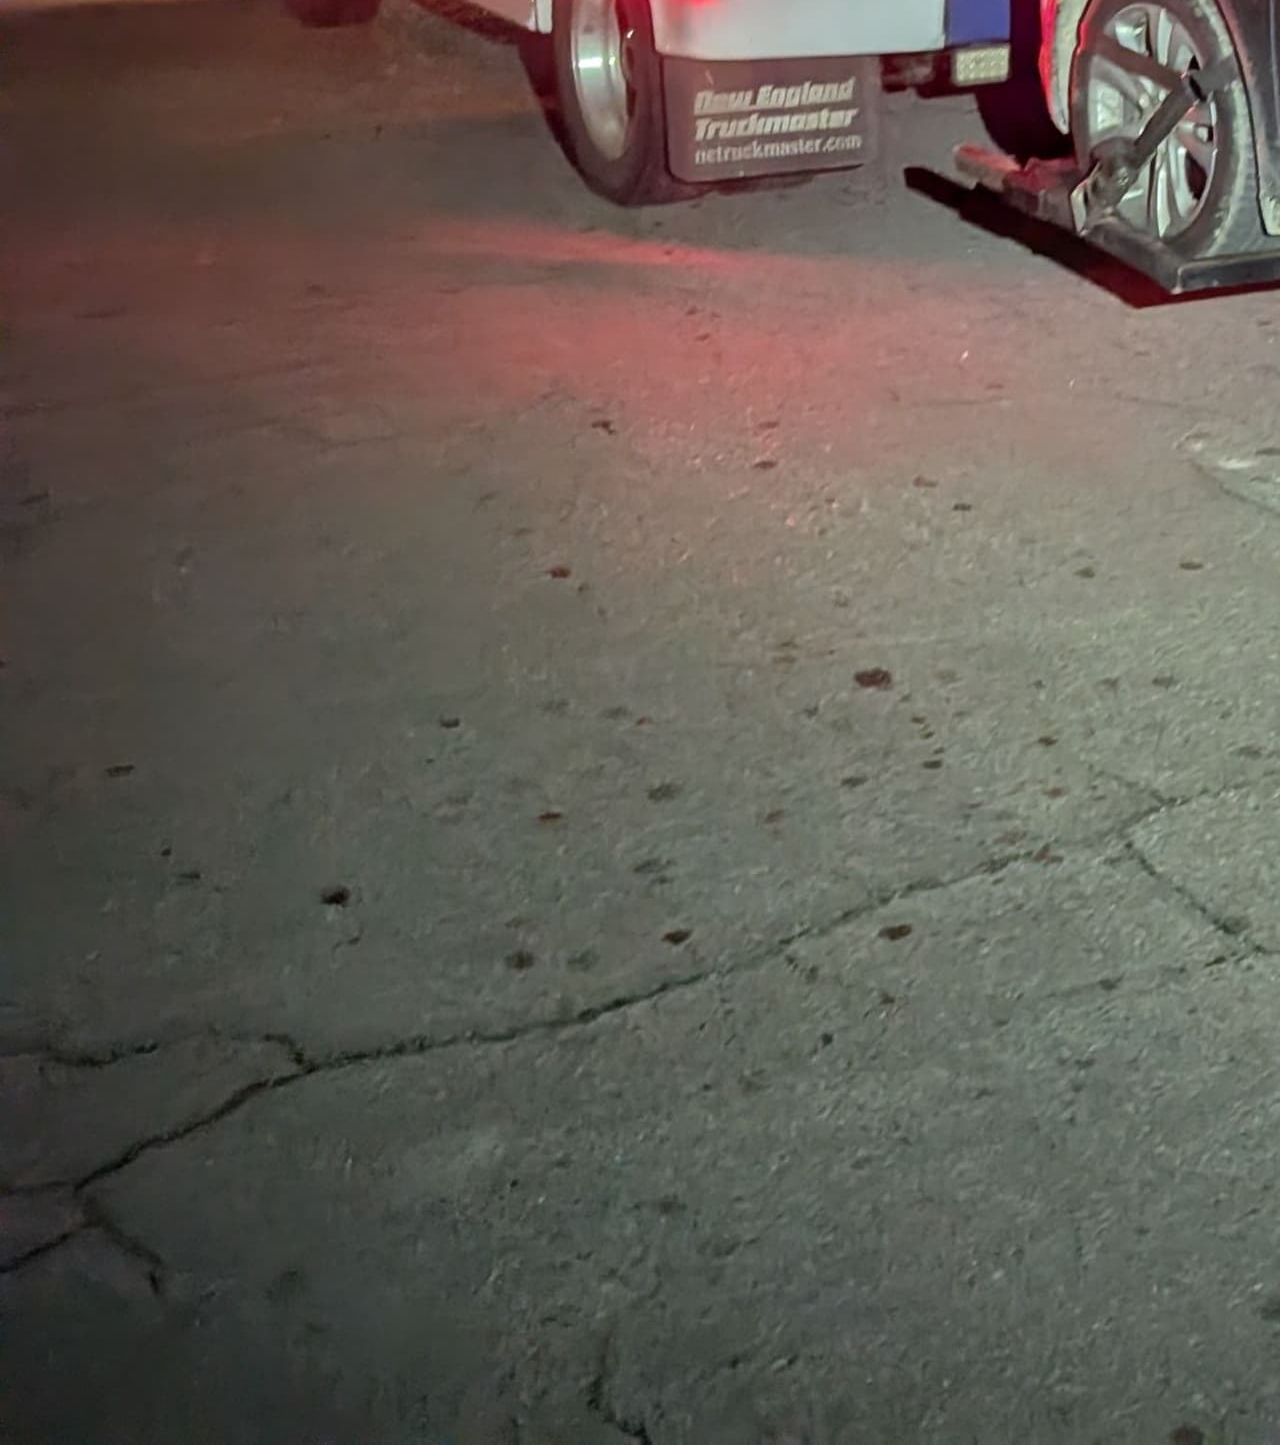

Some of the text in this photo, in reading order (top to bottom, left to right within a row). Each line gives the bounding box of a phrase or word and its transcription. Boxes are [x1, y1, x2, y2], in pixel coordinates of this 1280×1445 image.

[756, 77, 856, 107] England
[695, 108, 859, 141] Truckmaster
[695, 135, 862, 164] netruckmaster.com
